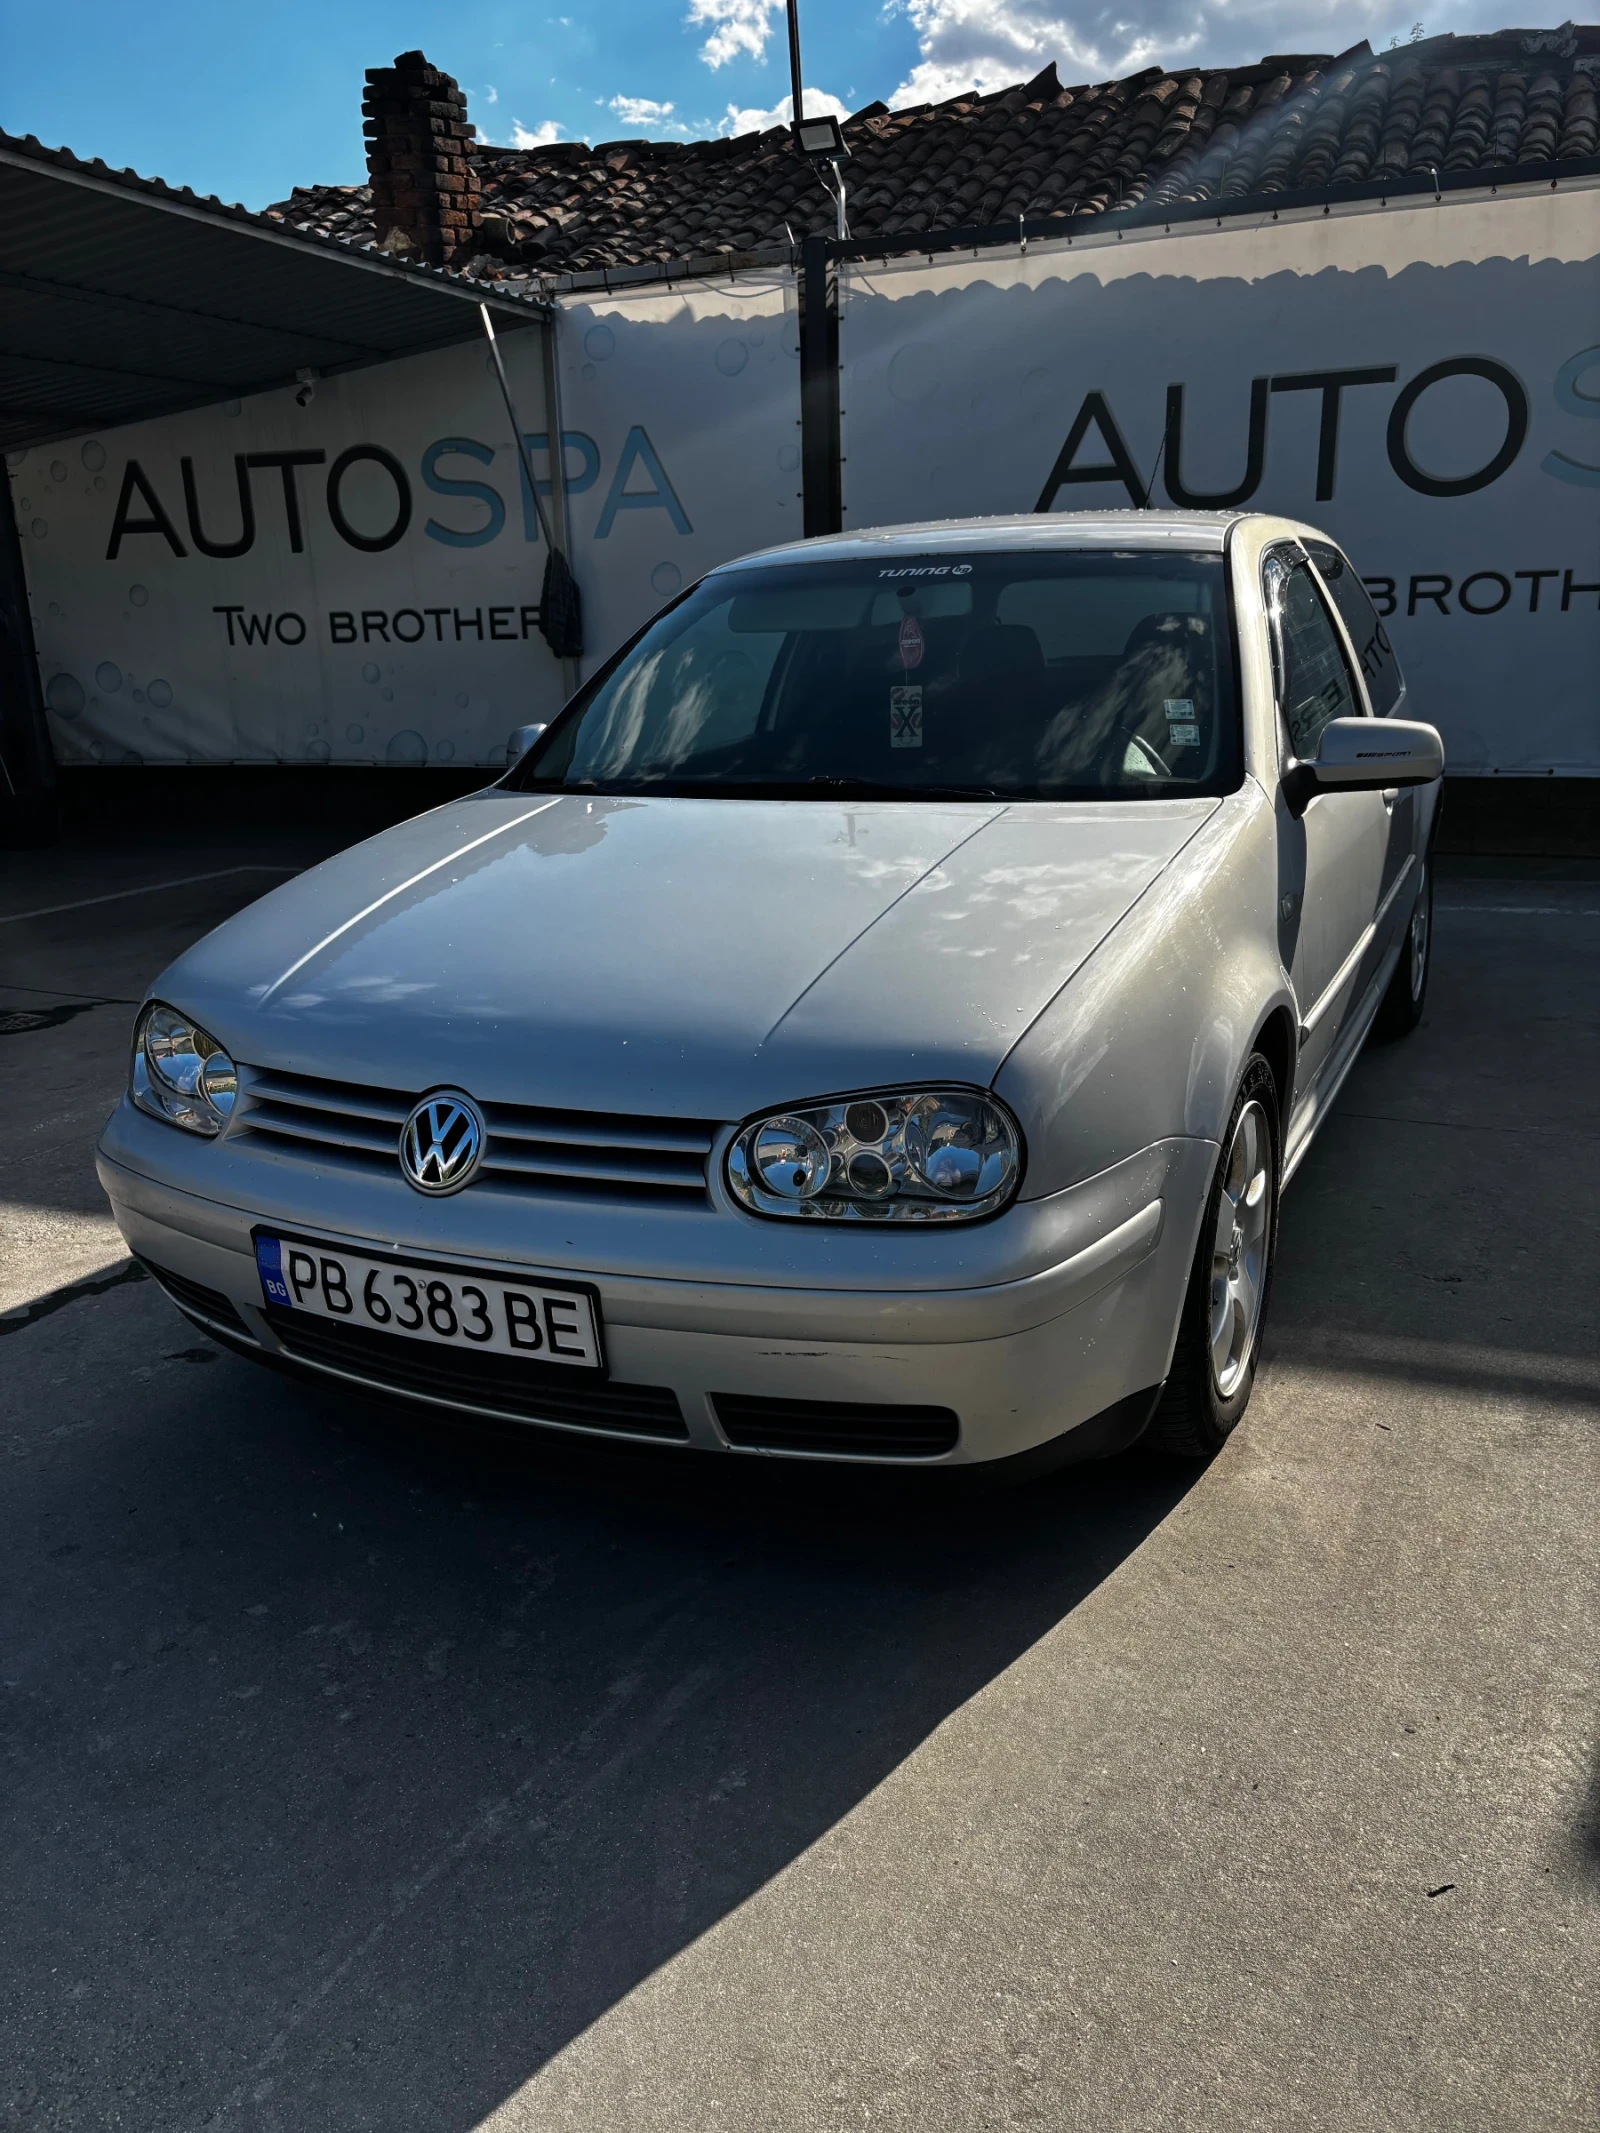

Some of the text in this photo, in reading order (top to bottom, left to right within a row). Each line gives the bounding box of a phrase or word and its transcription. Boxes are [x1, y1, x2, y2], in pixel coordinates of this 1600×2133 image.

[105, 424, 694, 559] AUTOSPA
[878, 566, 951, 578] TUNING
[893, 706, 920, 738] X
[266, 1278, 288, 1297] BG
[287, 1249, 587, 1358] PB 6383 BE
